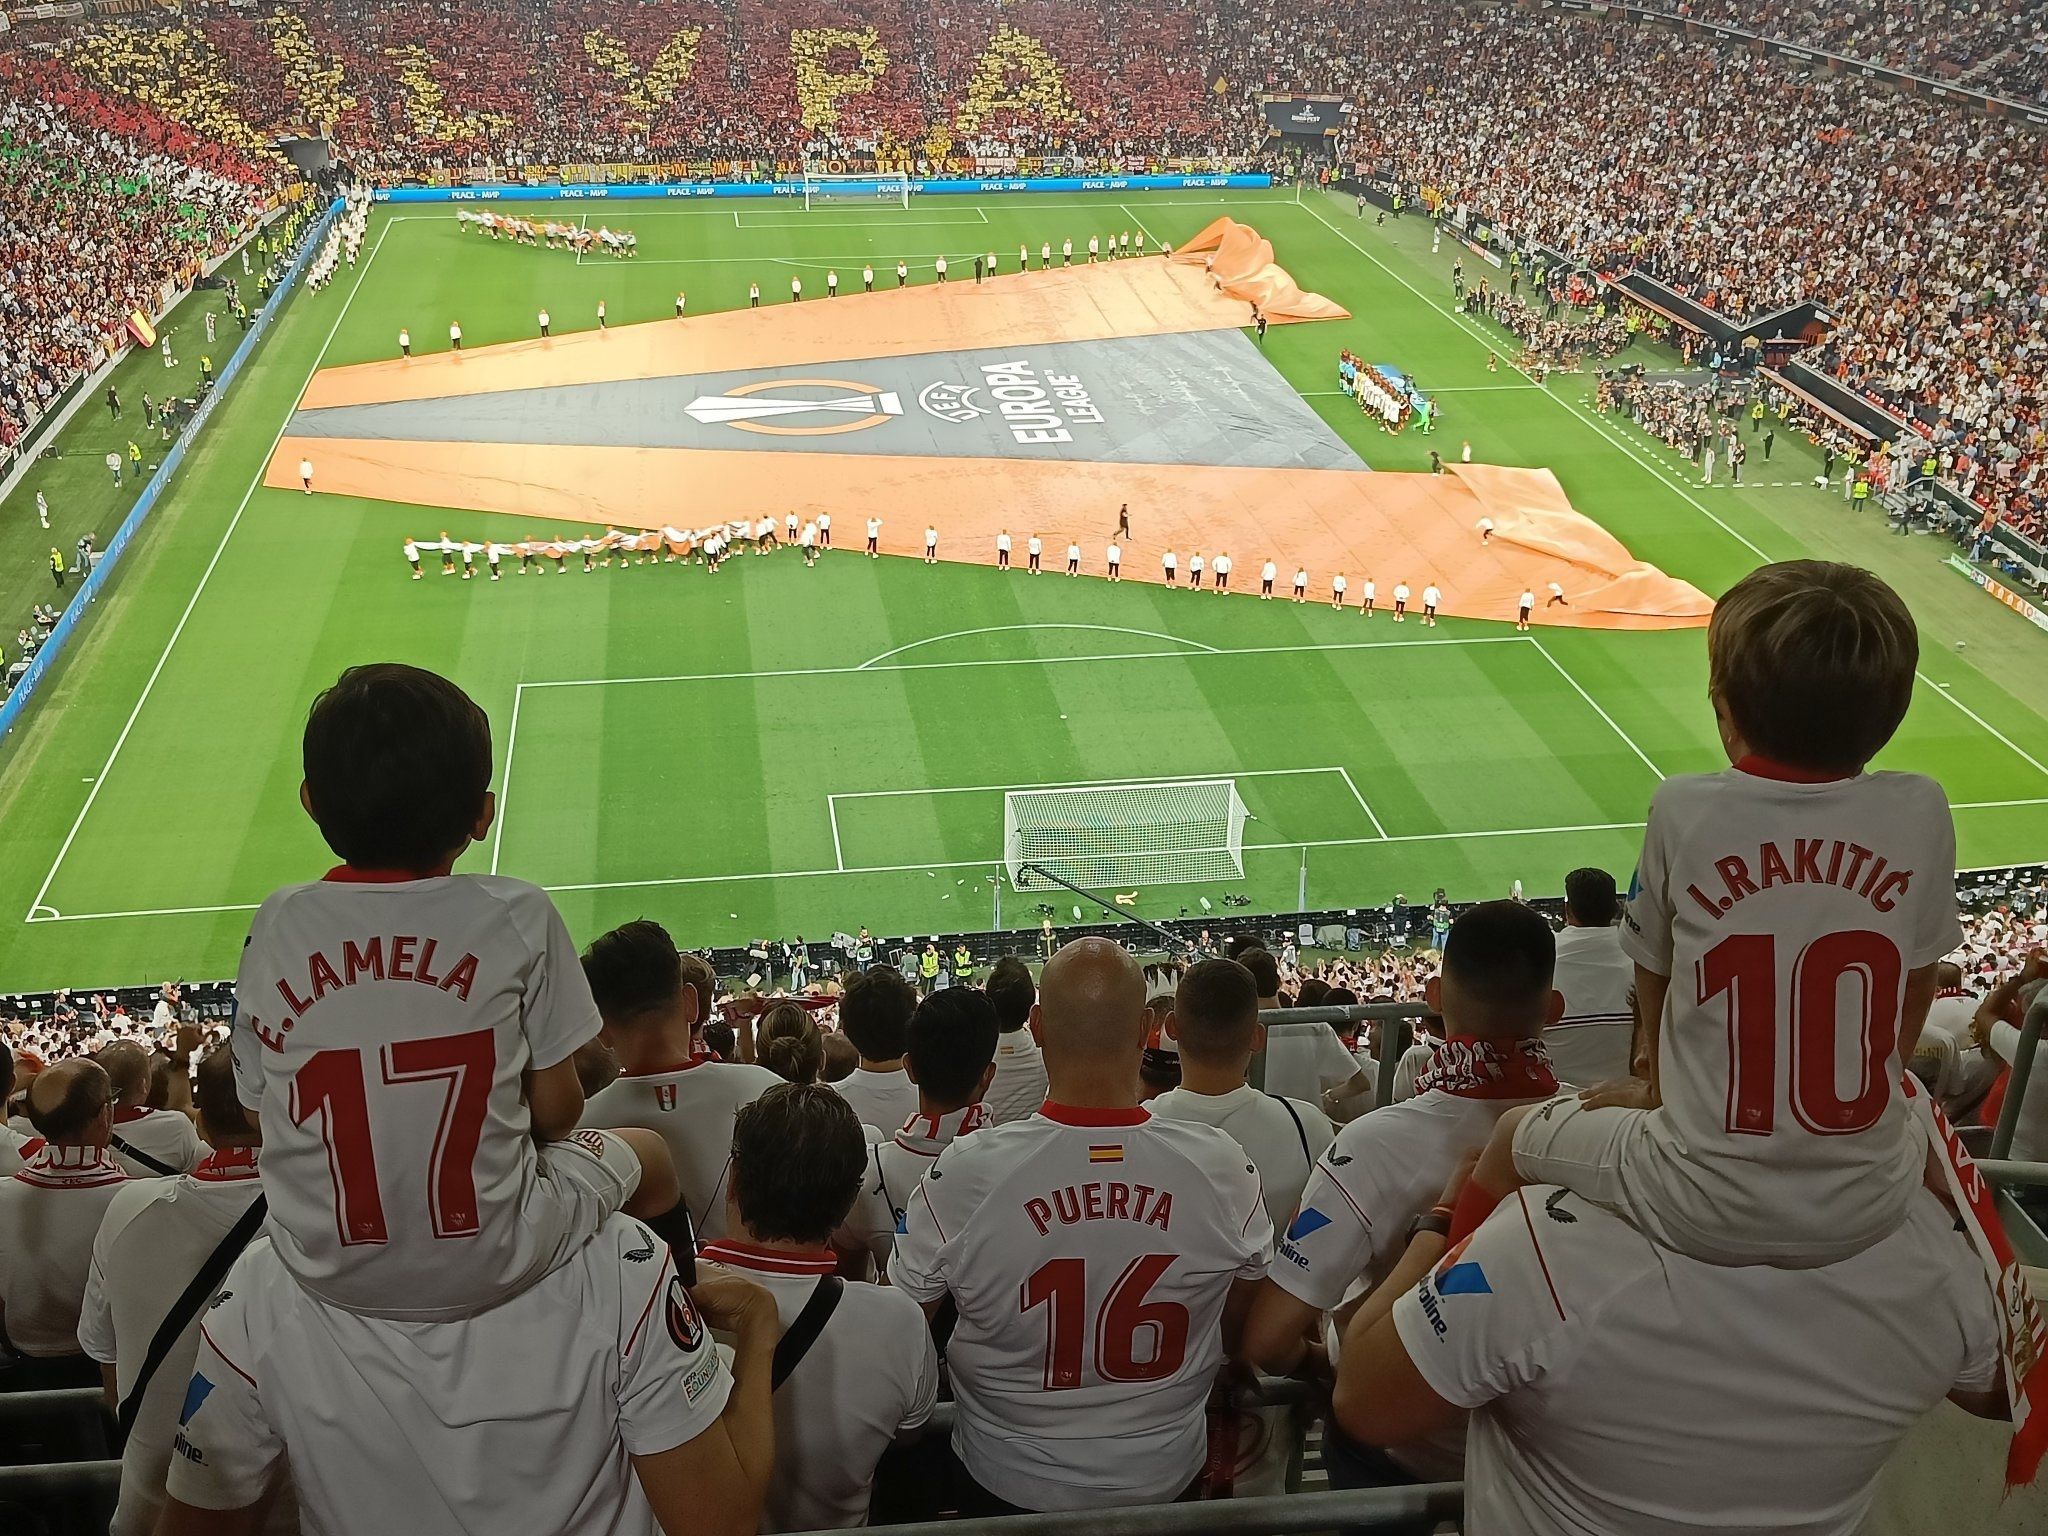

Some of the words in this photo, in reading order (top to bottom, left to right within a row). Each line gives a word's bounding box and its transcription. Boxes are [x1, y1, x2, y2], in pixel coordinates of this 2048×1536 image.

[452, 191, 476, 199] PEACE
[930, 384, 980, 421] UEFA
[981, 360, 1074, 444] EUROPA
[1046, 374, 1105, 424] LEAGUE
[1686, 838, 1914, 920] I.RAKITIĆ
[251, 935, 480, 1055] E.LAMELA
[1694, 929, 1902, 1137] 10
[289, 1028, 496, 1248] 17
[1023, 1181, 1174, 1237] PUERTA
[1019, 1253, 1191, 1391] 16
